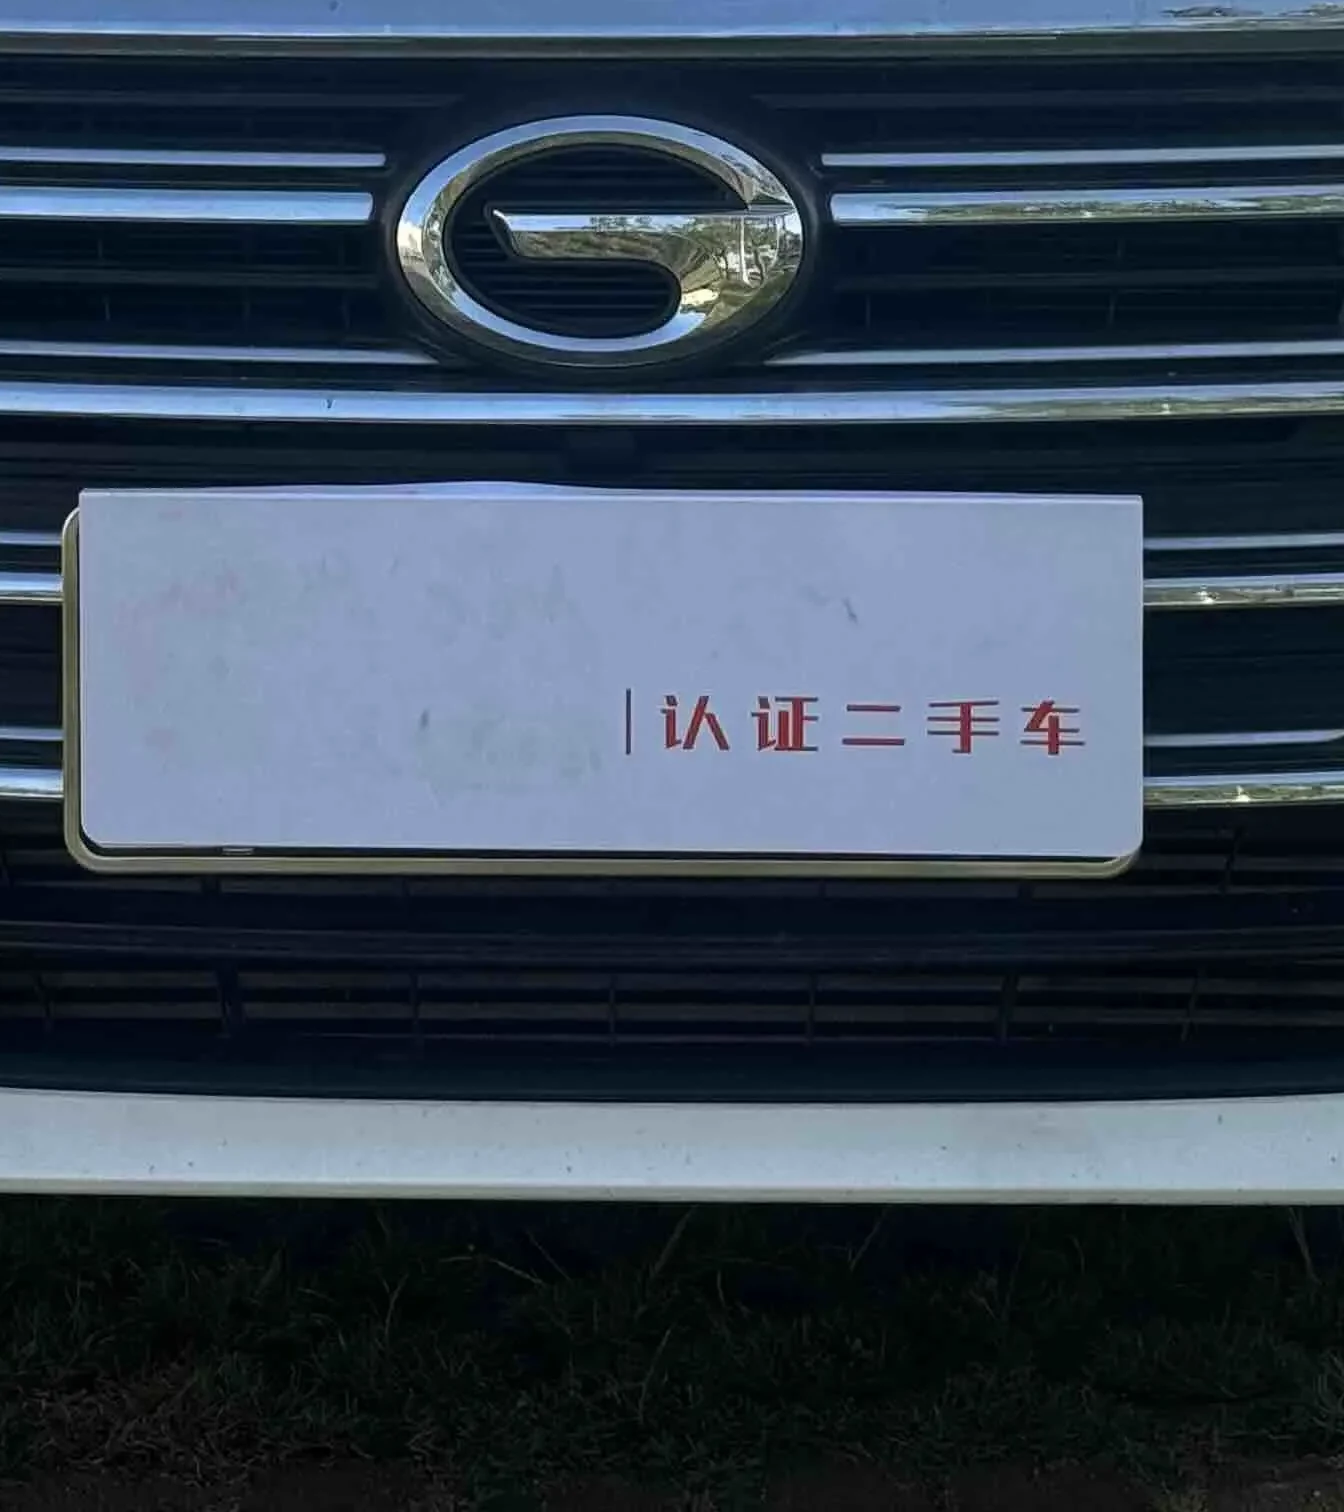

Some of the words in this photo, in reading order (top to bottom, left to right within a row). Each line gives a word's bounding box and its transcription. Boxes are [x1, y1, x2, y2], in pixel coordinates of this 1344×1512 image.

[660, 694, 1086, 755] 认证二手车
